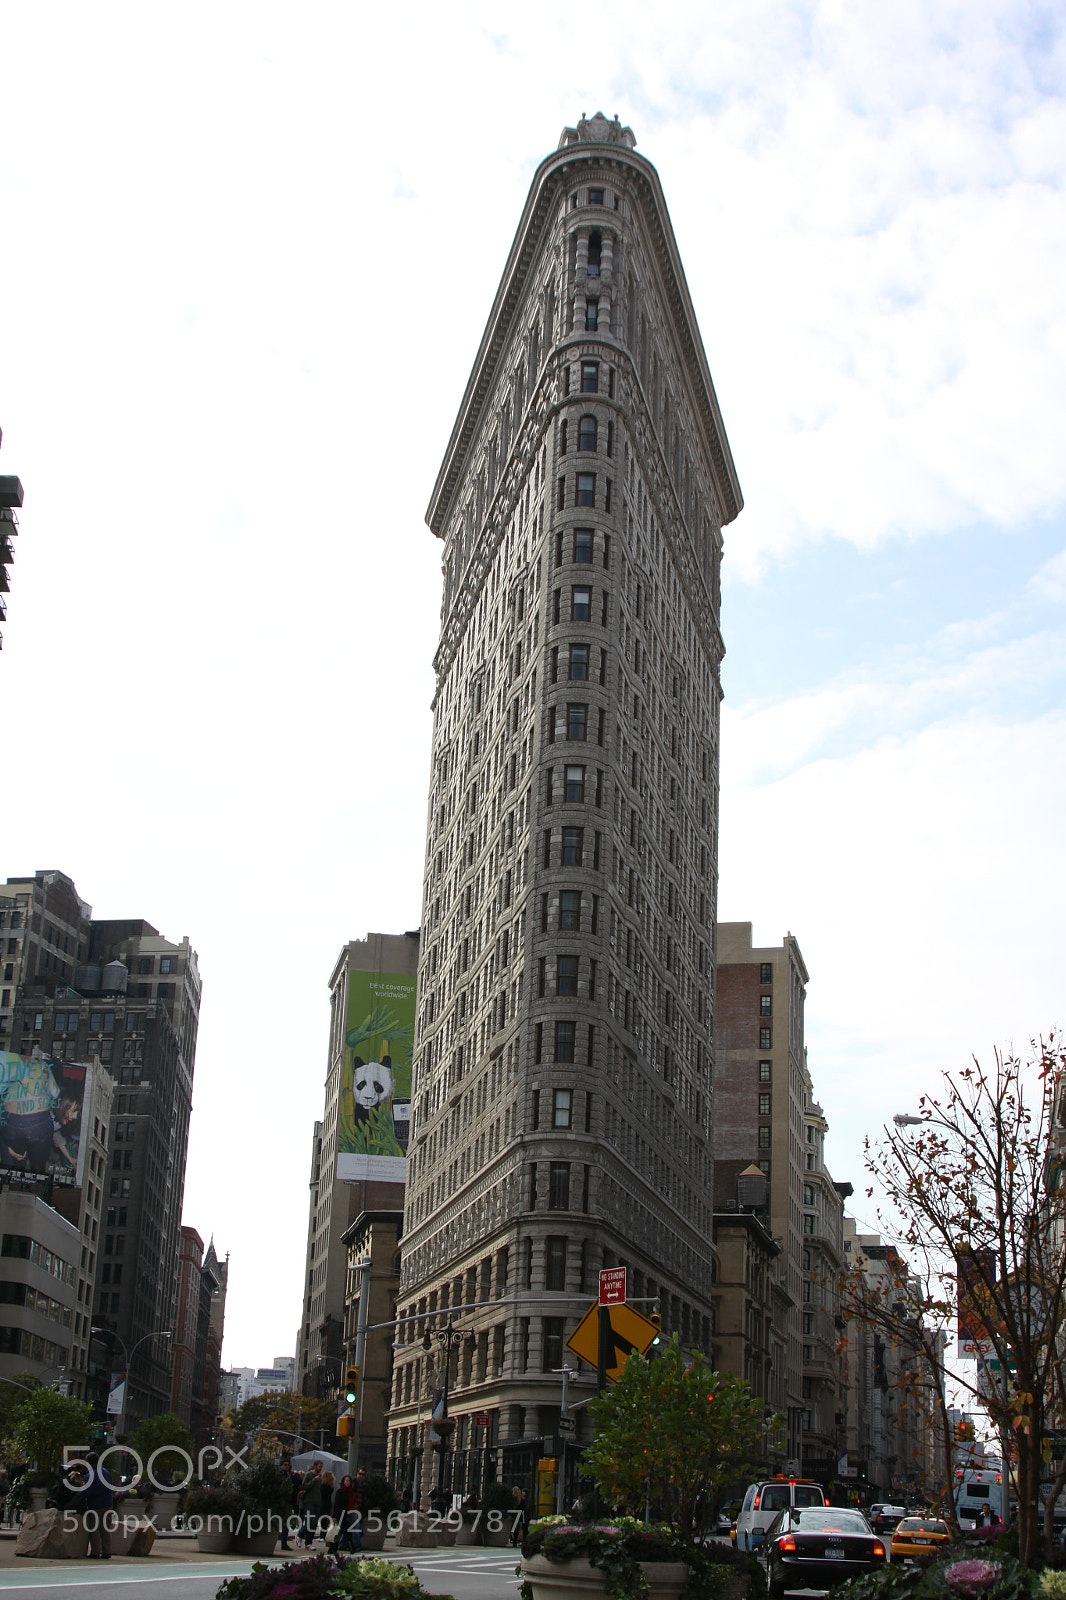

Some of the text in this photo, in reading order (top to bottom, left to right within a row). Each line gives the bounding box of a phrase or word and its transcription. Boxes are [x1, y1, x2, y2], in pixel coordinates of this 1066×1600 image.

[386, 984, 415, 993] coverage
[16, 1082, 30, 1099] IN
[33, 1080, 52, 1097] ALL
[16, 1099, 35, 1114] AND
[601, 1273, 607, 1281] NO
[604, 1281, 622, 1290] ANYTIME
[963, 1344, 991, 1352] GREY
